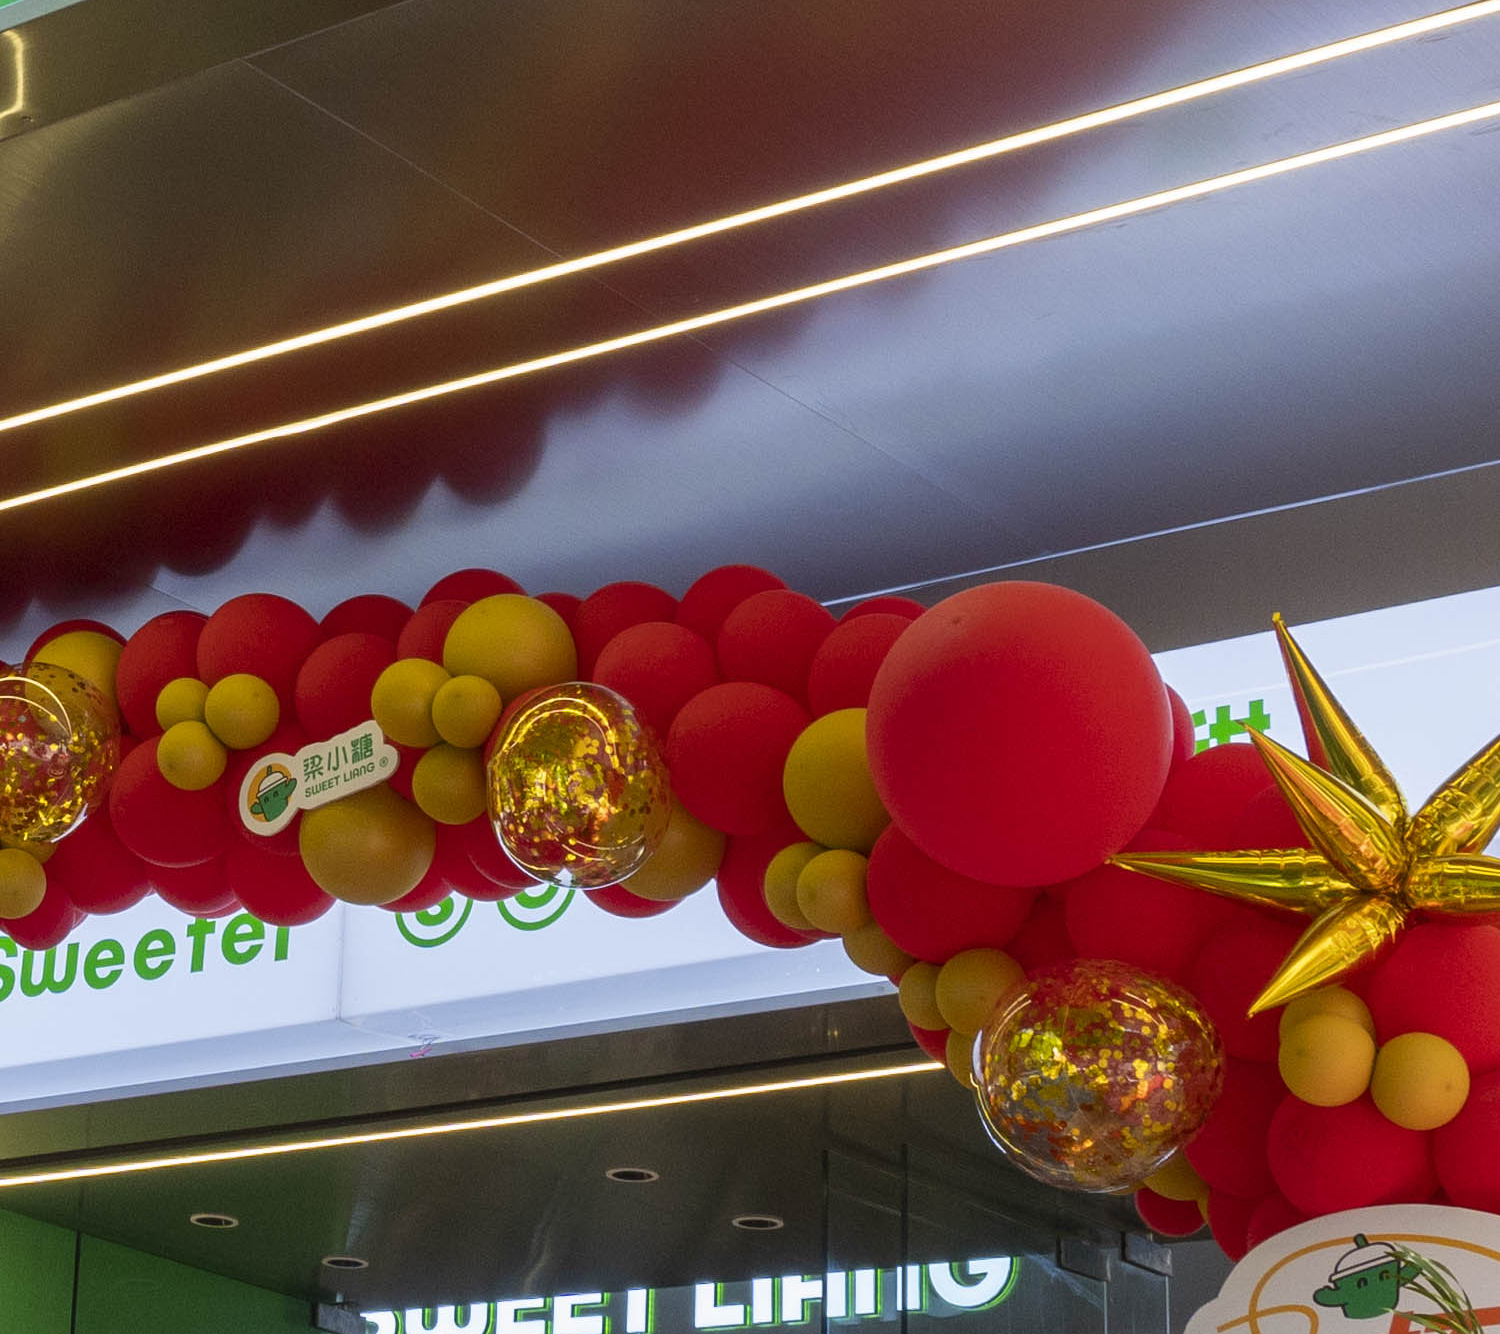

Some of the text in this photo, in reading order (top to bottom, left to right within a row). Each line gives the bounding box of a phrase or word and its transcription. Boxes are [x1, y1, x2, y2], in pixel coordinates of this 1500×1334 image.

[303, 733, 374, 782] 梁小糖
[304, 762, 376, 798] SWEET LIANG
